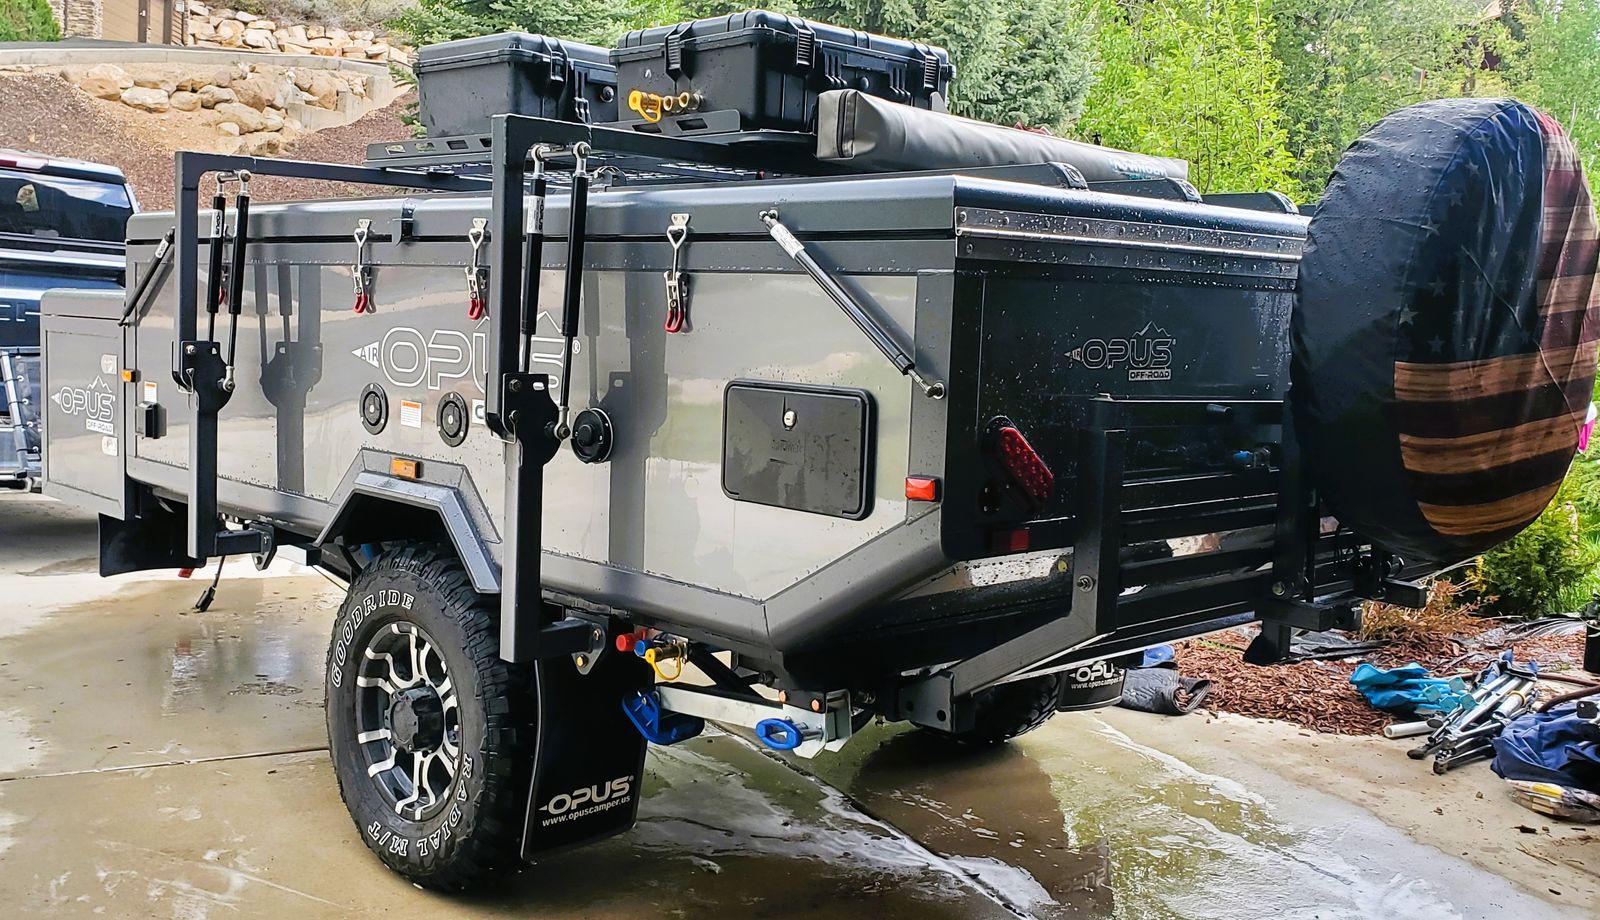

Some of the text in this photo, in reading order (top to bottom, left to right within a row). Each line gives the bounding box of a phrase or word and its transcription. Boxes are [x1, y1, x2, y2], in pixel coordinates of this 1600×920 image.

[360, 347, 379, 362] AIR
[1082, 338, 1172, 369] OPUS
[1130, 370, 1170, 380] OFF-ROAD
[60, 386, 114, 422] OPUS
[331, 590, 415, 688] GOODRIDE
[367, 753, 473, 856] RADIAL M/T
[542, 795, 631, 827] www.opuscamper.us
[548, 775, 630, 815] OPUS
